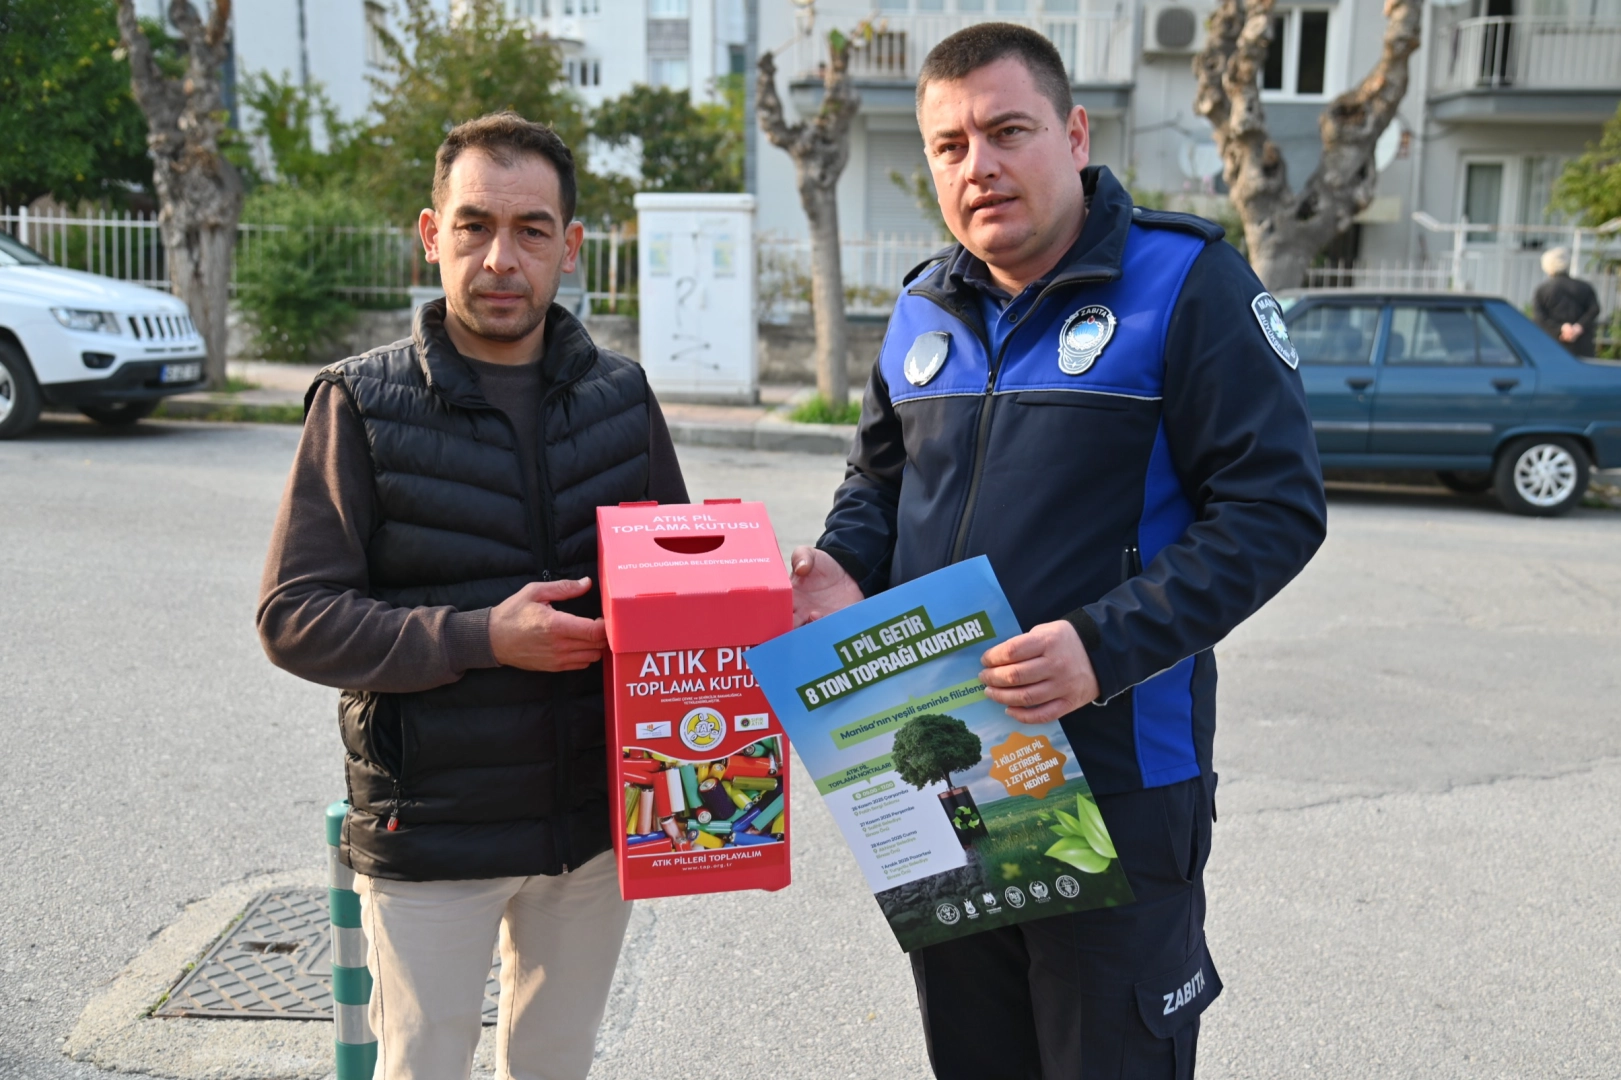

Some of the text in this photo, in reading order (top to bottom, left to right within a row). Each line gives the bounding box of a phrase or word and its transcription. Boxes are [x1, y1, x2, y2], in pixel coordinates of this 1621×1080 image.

[1080, 308, 1108, 317] ZABITA
[612, 522, 760, 534] TOPLAMA KUTUSU
[840, 614, 926, 663] 1 PİL GETİR
[639, 650, 708, 678] ATIK
[805, 618, 985, 705] 8 TON TOPRAĞI KURTAR!
[626, 674, 760, 697] TOPLAMA KUTU
[892, 706, 916, 723] yeşili
[916, 694, 950, 712] seninle
[950, 683, 987, 700] filizlens
[696, 722, 714, 733] TAP
[994, 739, 1044, 768] 1 KİLO ATIK PİL
[1008, 753, 1042, 774] GETİRENE
[828, 762, 892, 788] TOPLAMA NOKTALARI
[846, 768, 859, 776] ATIK
[1004, 757, 1059, 788] 1 ZEYTİN FİDANI
[1023, 774, 1050, 790] HEDİYE!
[652, 850, 762, 867] ATIK PİLLERİ TOPLAYALIM
[682, 862, 732, 871] www.tap.org.tr
[1163, 967, 1205, 1016] ZABITA
